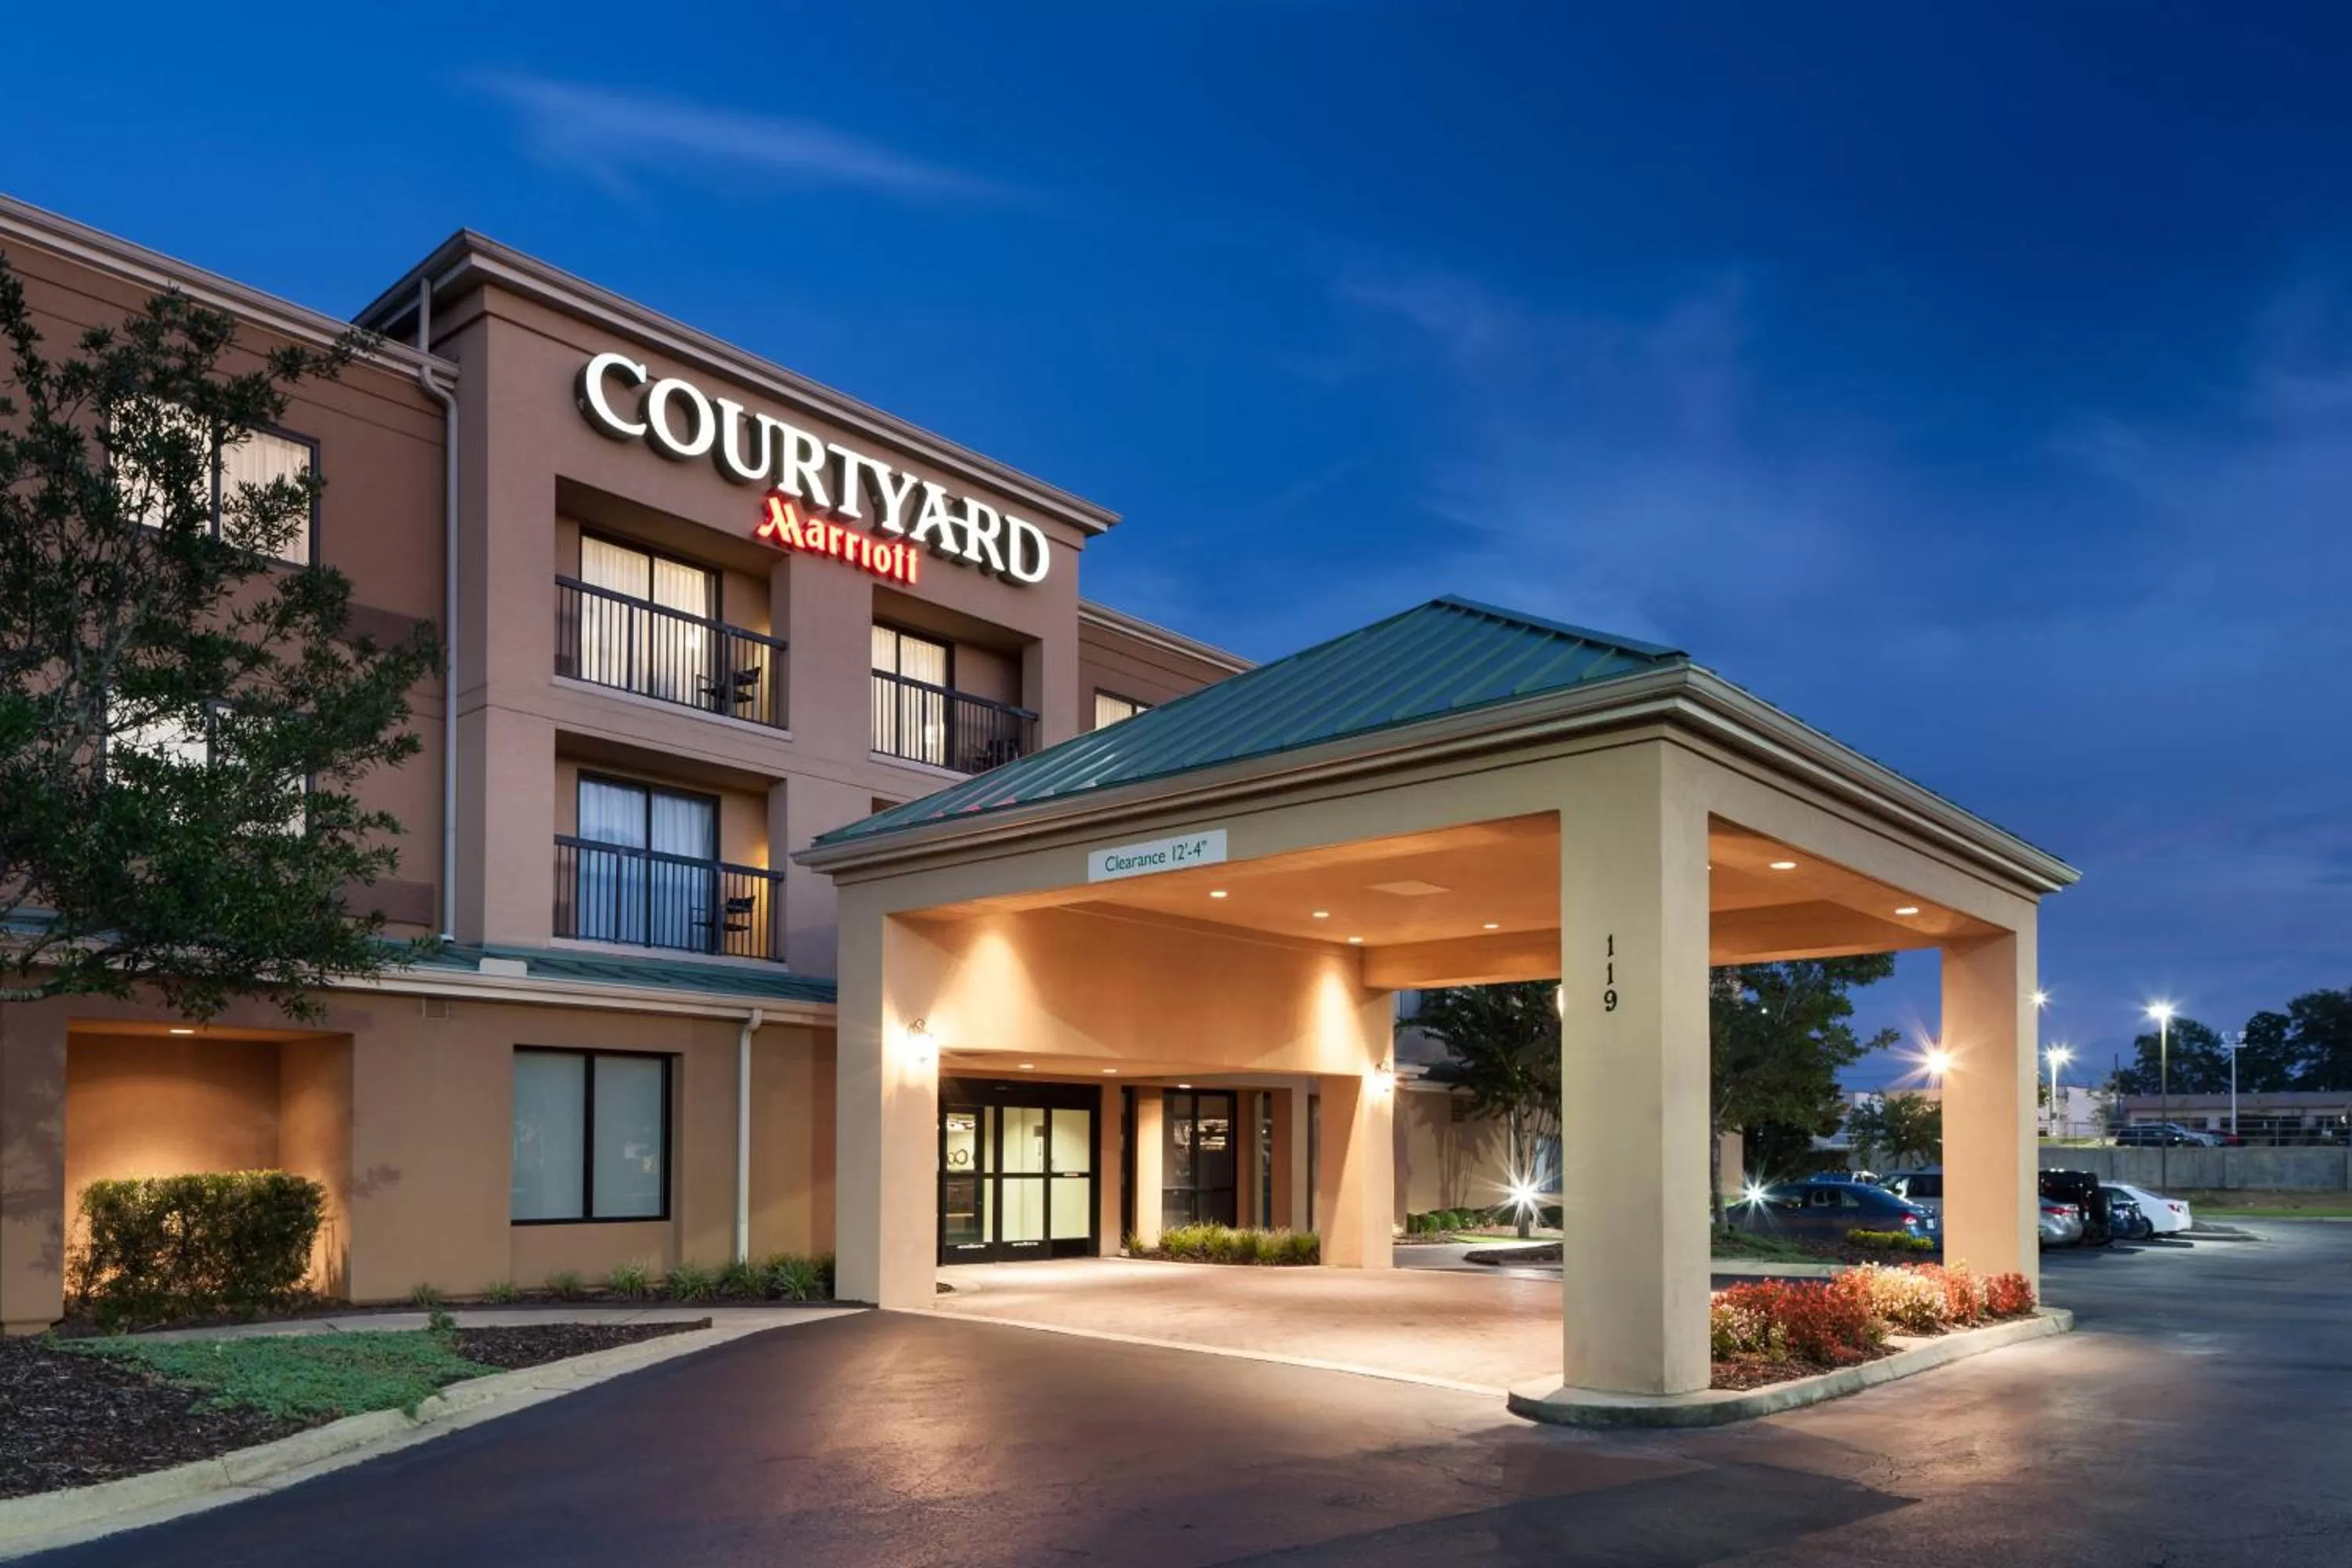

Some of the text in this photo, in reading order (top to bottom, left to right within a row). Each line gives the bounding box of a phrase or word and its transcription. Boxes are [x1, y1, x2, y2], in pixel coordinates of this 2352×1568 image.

[583, 351, 1051, 585] COURTYARD
[756, 495, 918, 585] Marriott
[1105, 840, 1208, 872] Clearance 12'-4"
[1603, 934, 1617, 1012] 119
